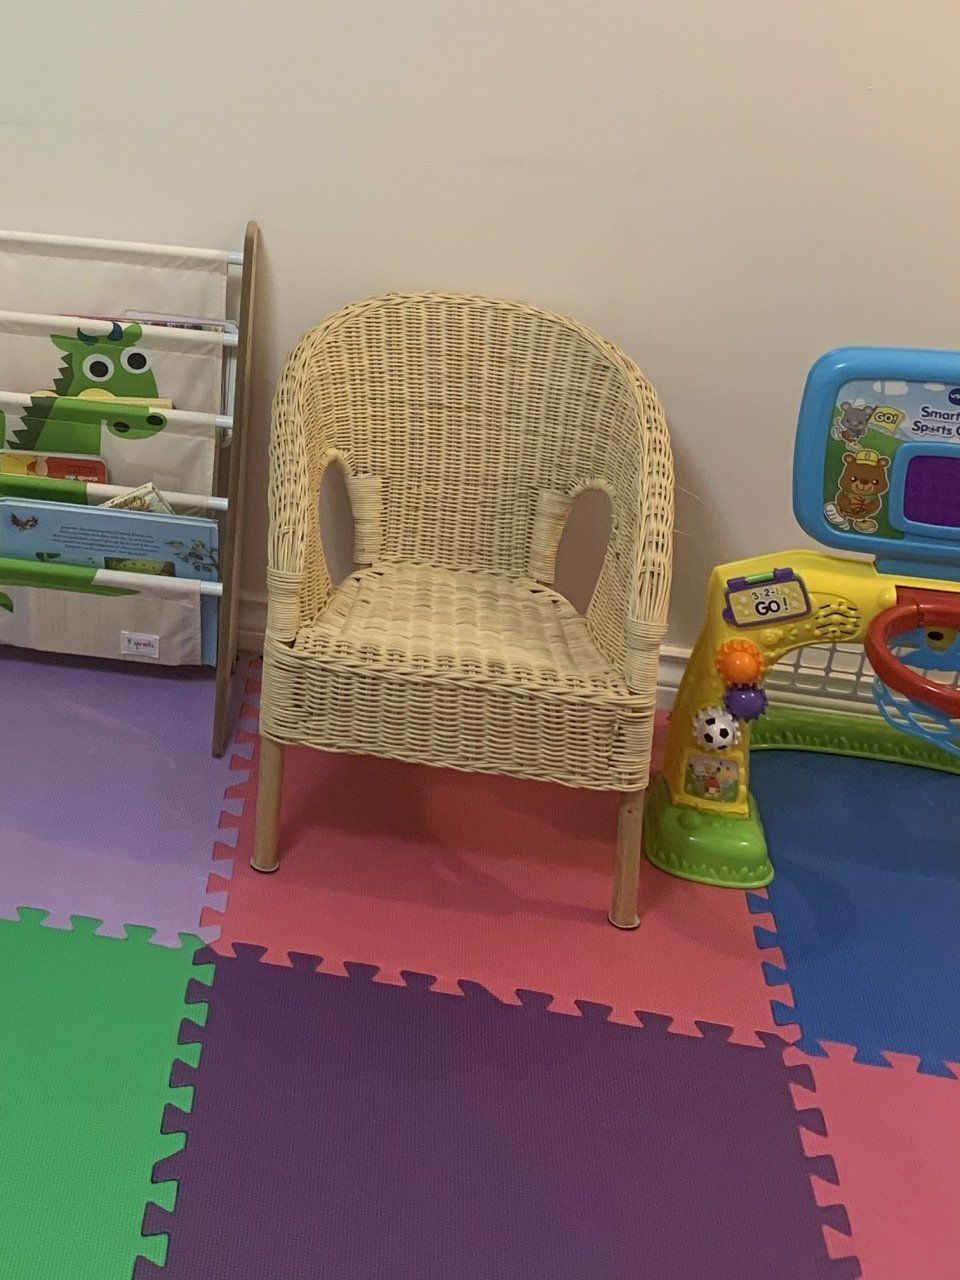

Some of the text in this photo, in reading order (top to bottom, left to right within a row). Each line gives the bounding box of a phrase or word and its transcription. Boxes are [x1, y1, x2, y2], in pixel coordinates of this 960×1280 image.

[875, 412, 899, 424] GO!
[921, 406, 960, 421] Smart
[755, 596, 788, 616] GO!
